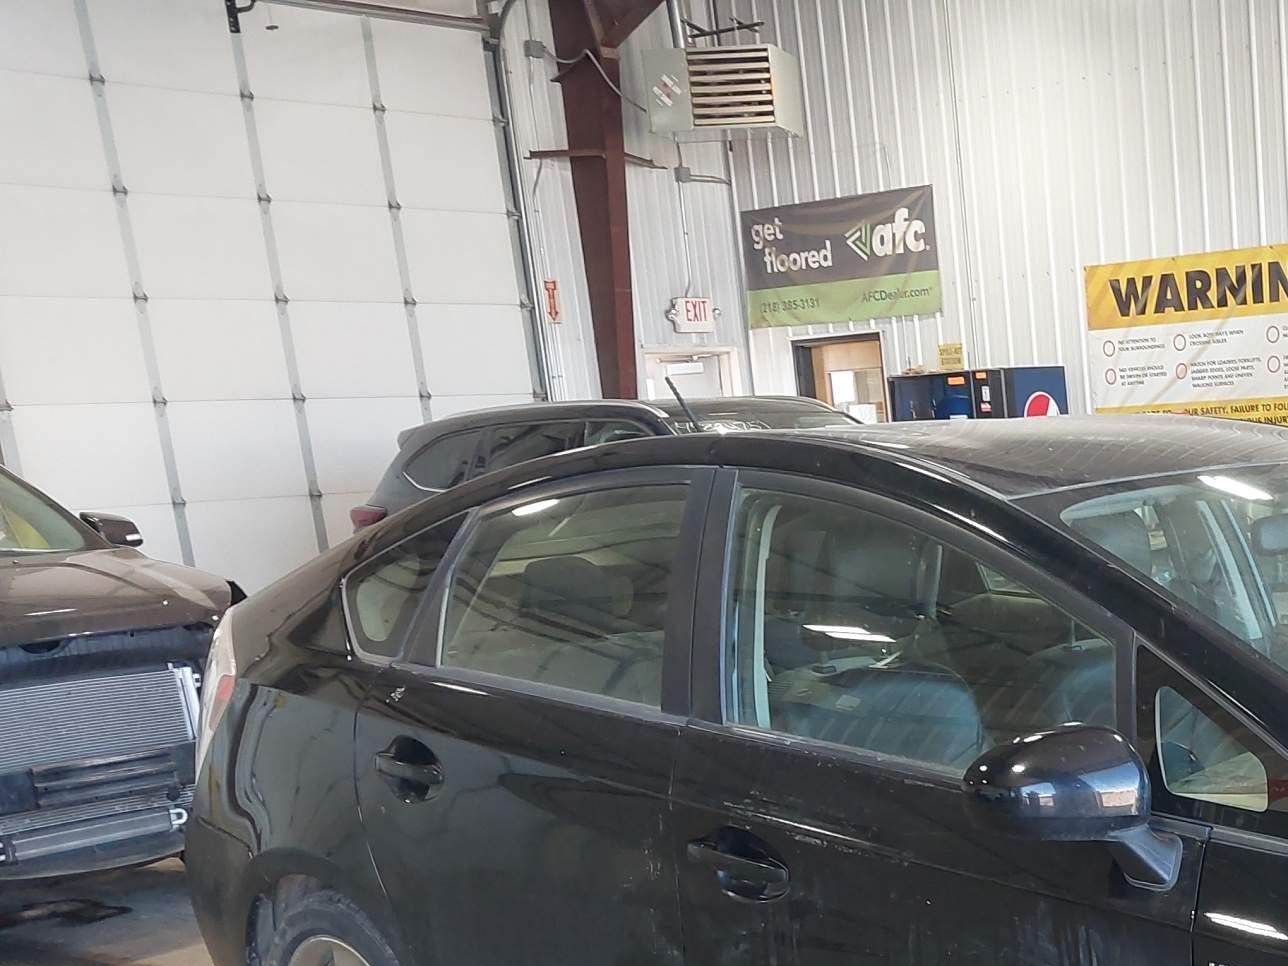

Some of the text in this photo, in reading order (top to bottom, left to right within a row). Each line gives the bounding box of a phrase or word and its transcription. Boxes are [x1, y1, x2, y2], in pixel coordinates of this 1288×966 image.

[751, 217, 784, 250] get
[872, 207, 926, 257] afc
[764, 239, 832, 273] floored
[685, 300, 707, 322] EXIT
[1200, 405, 1229, 416] SAFETY.
[1231, 402, 1260, 414] FAILURE
[1262, 403, 1272, 412] TO
